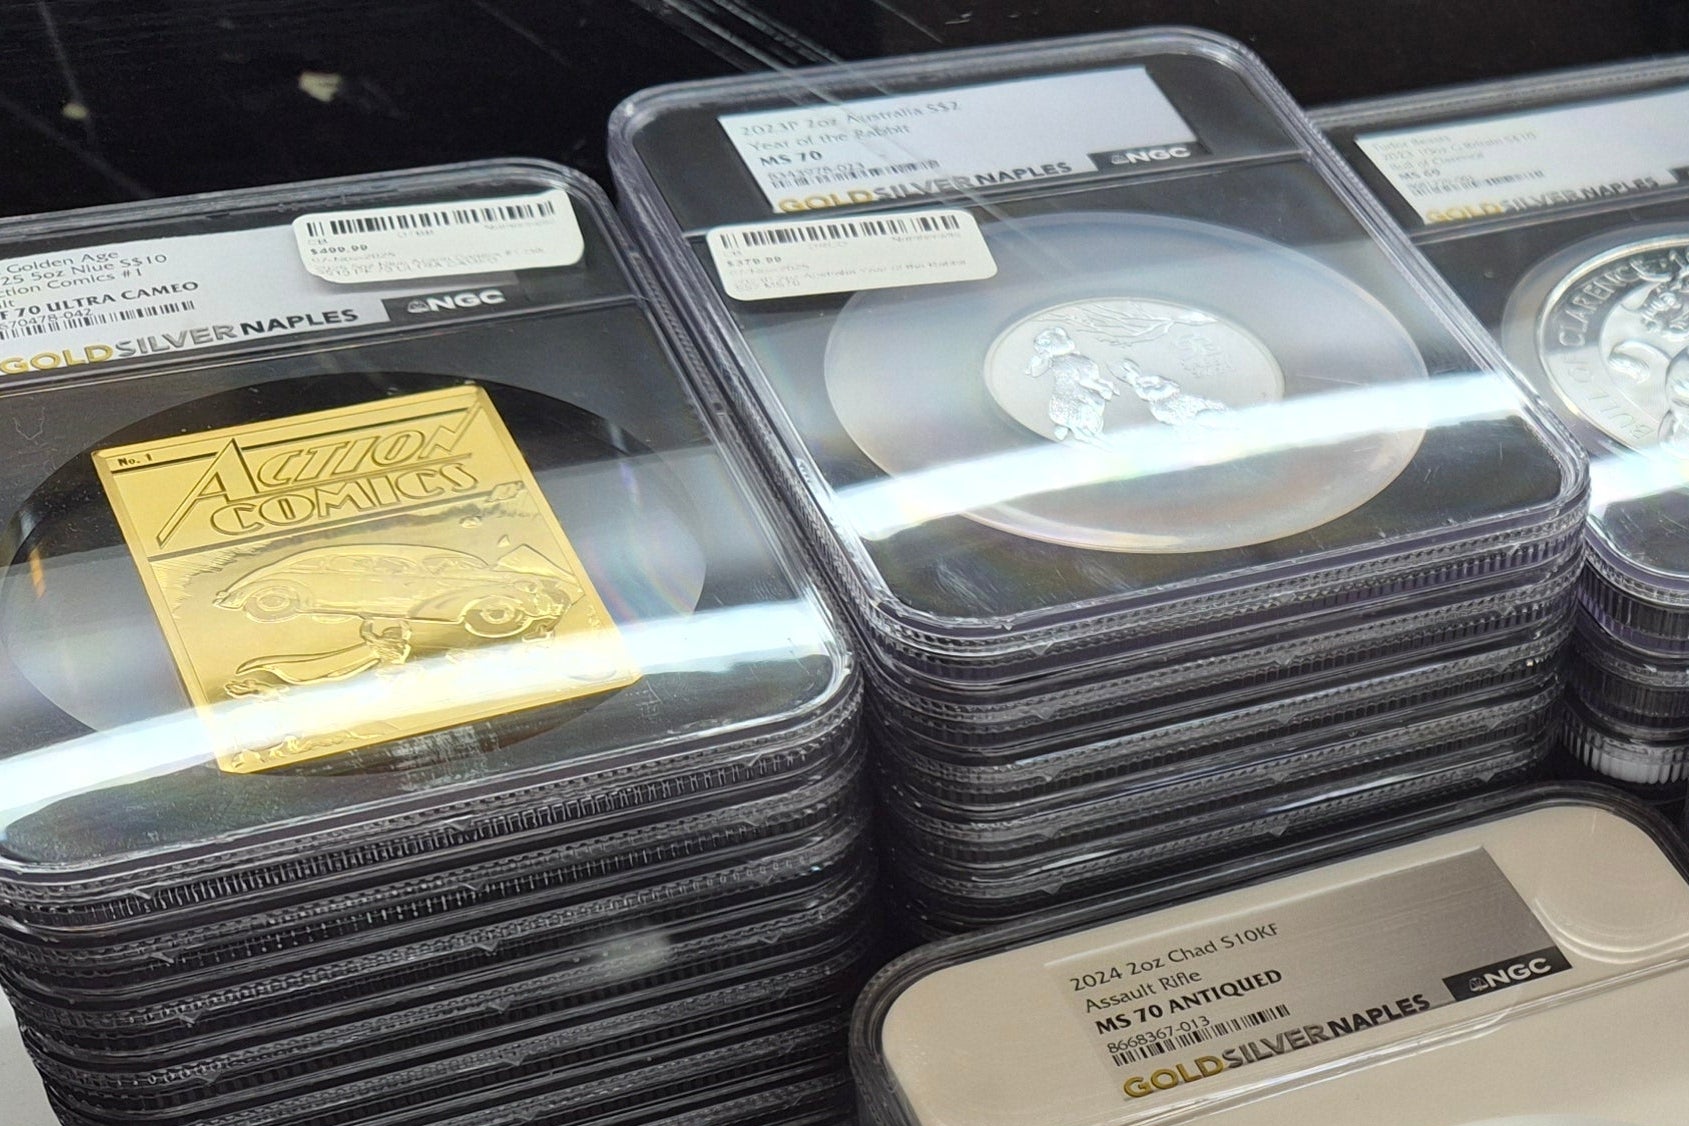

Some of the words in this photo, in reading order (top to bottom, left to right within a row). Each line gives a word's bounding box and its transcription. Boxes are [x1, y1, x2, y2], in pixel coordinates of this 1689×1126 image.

[847, 108, 922, 125] Australia
[747, 138, 790, 152] Year
[795, 134, 814, 148] of
[819, 132, 848, 144] the
[759, 154, 792, 167] MS
[799, 150, 823, 162] 70
[1125, 146, 1192, 164] NGC
[777, 160, 1073, 214] GOLDSILVERNAPLES
[6, 256, 74, 274] Golden
[81, 251, 119, 264] Age
[31, 270, 66, 282] 5oz
[71, 262, 115, 276] Niue
[0, 284, 41, 299] ction
[47, 273, 116, 290] Comics
[122, 268, 142, 279] #1
[14, 305, 41, 318] 70
[47, 293, 116, 313] ULTRA
[121, 281, 199, 300] CAMEO
[426, 289, 505, 312] NGC
[0, 308, 359, 374] GOLDSILVERNAPLES
[211, 464, 478, 536] COMICS
[1070, 967, 1123, 992] 2024
[1126, 957, 1165, 976] 2oz
[1168, 940, 1218, 963] Chad
[1220, 923, 1279, 949] S10KF
[1485, 957, 1553, 989] NGC
[1085, 984, 1157, 1013] Assault
[1158, 969, 1202, 991] Rifle
[1095, 1014, 1132, 1035] MS
[1133, 1004, 1163, 1023] 70
[1169, 969, 1283, 1014] ANTIQUED
[1107, 1015, 1211, 1054] 8668367-013
[1123, 993, 1431, 1099] GOLDSILVERNAPLES
